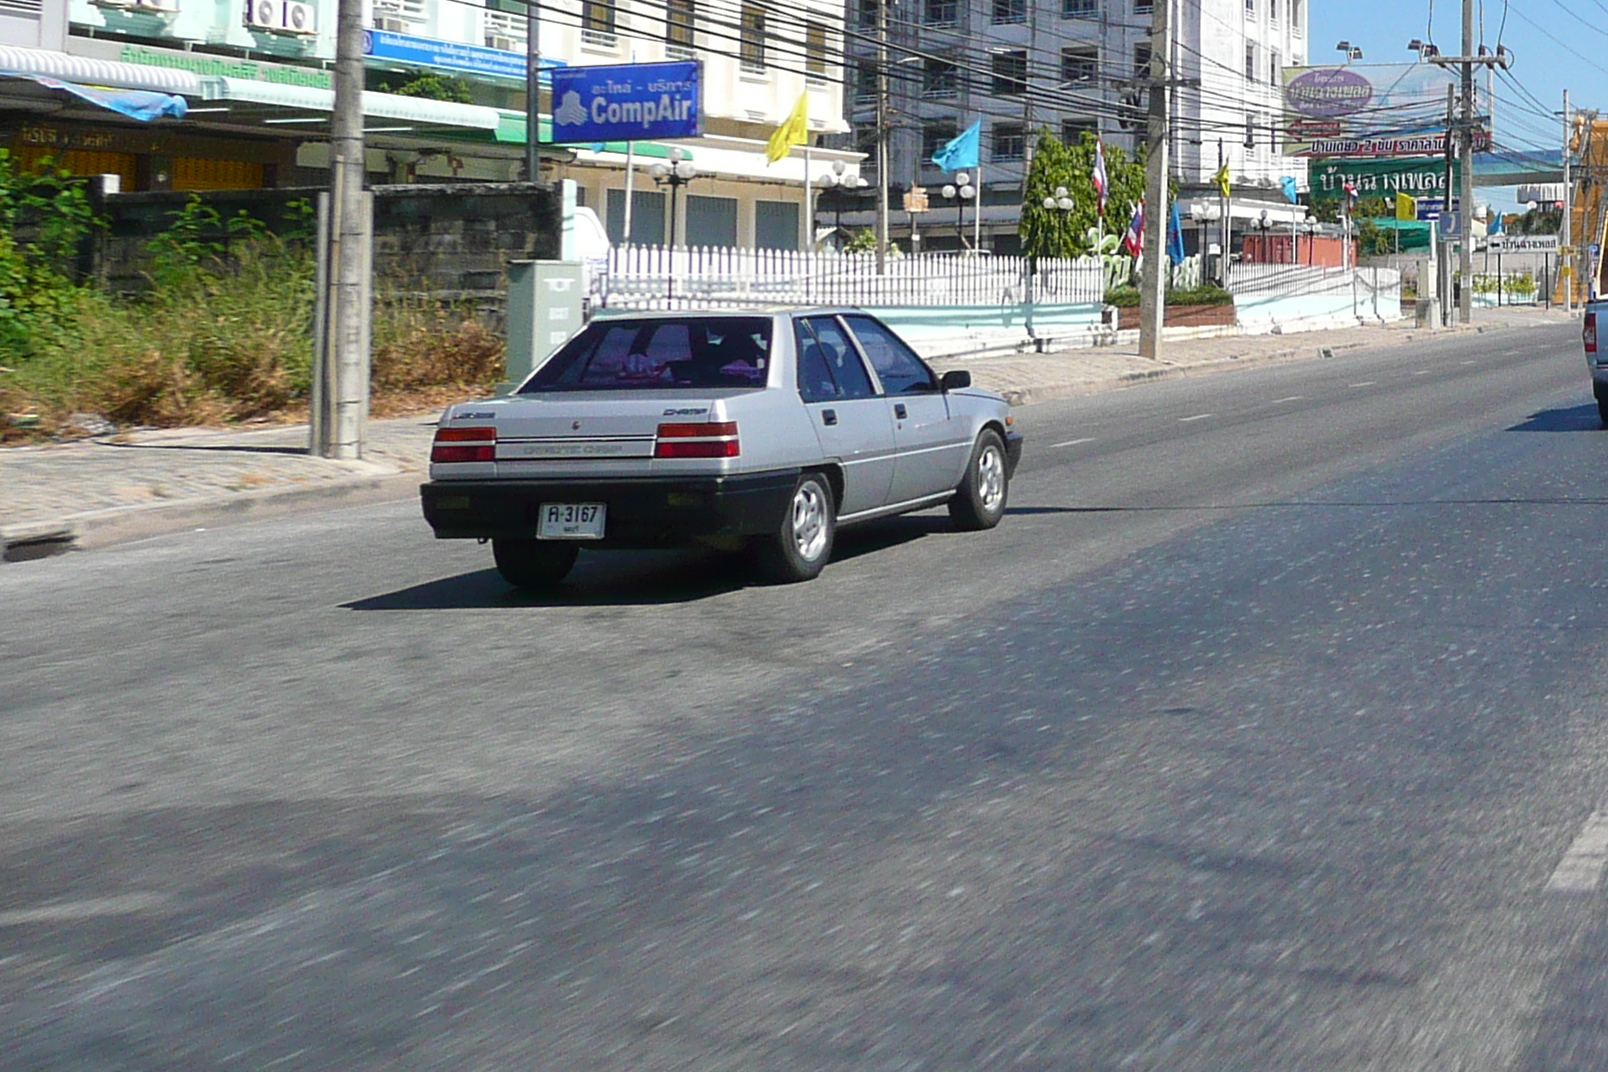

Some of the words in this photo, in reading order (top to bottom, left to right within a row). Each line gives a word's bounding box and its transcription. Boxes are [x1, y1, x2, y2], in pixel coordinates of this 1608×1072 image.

[647, 78, 692, 93] บริการ
[591, 94, 692, 128] CompAir
[1363, 139, 1374, 153] 2
